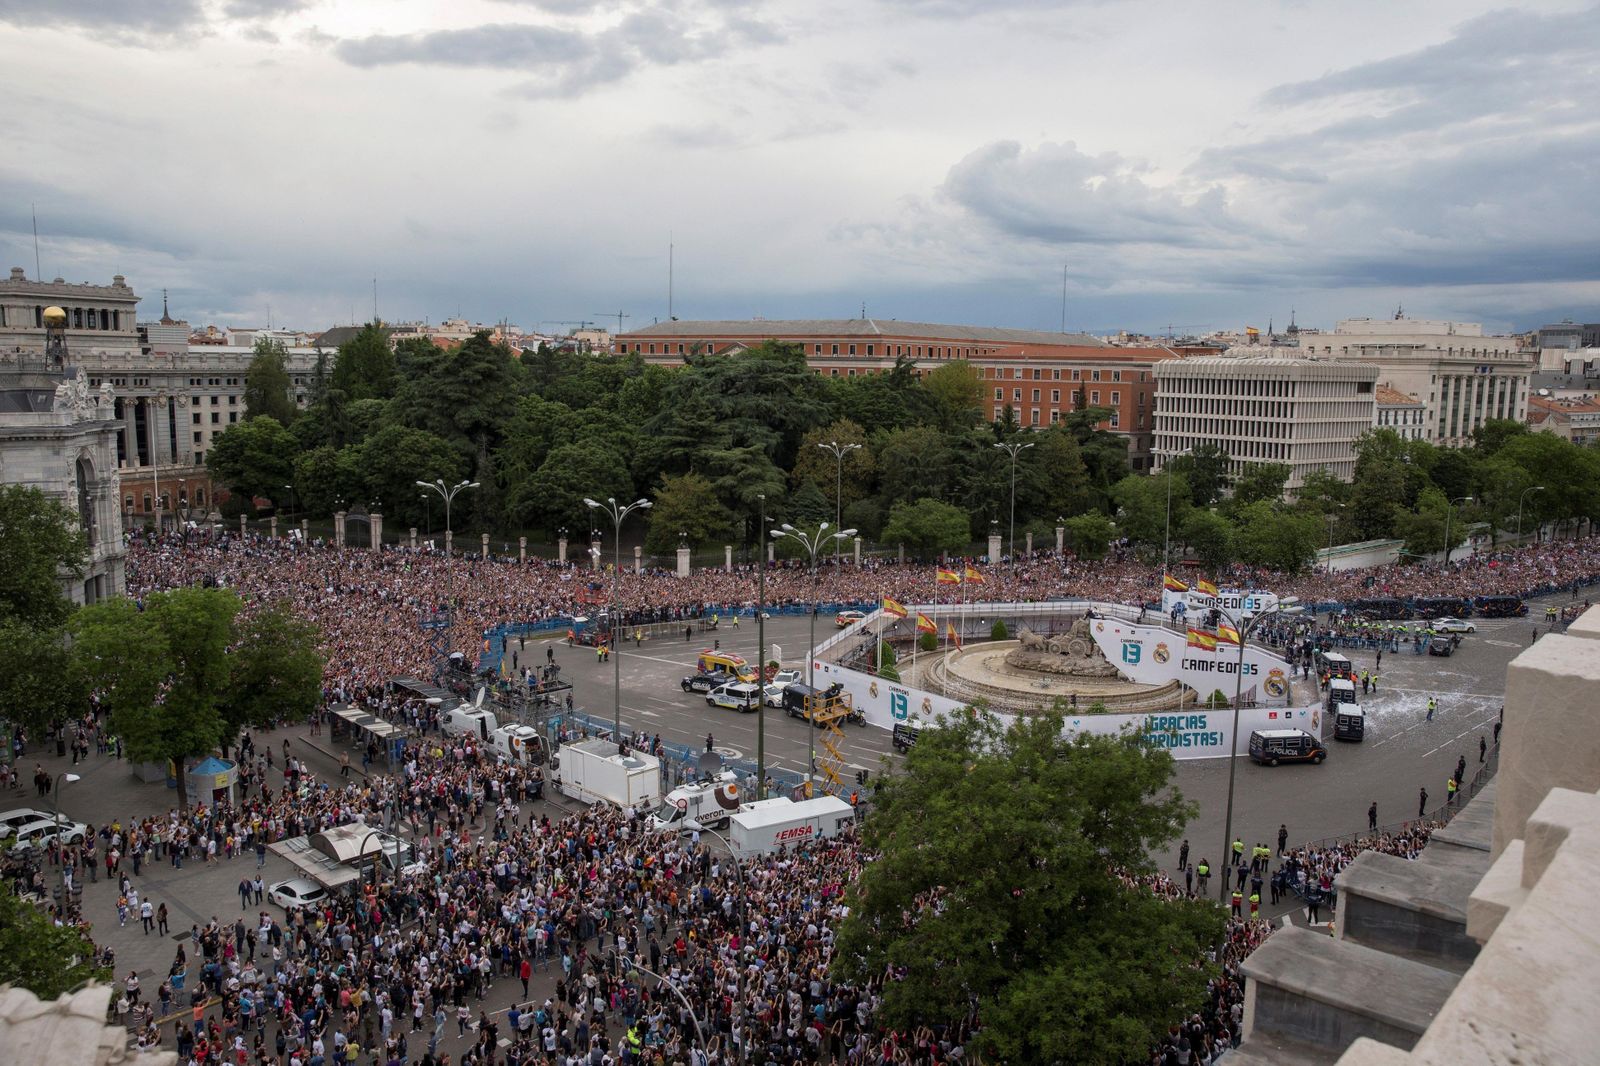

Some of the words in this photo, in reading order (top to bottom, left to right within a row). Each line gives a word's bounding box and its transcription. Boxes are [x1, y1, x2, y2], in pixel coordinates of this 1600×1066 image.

[1122, 643, 1141, 663] 13
[890, 692, 908, 720] 13
[694, 809, 725, 822] overon
